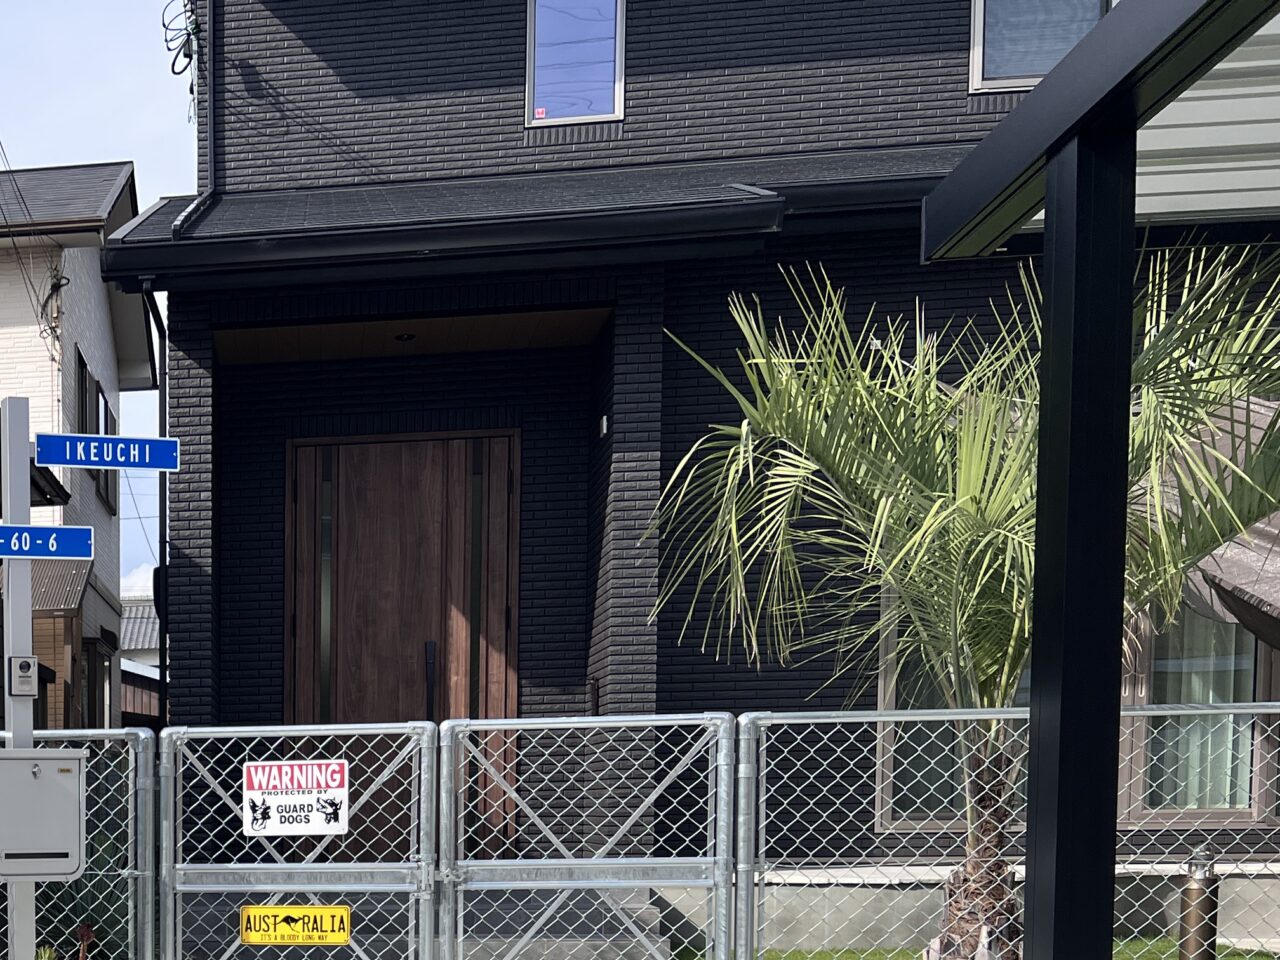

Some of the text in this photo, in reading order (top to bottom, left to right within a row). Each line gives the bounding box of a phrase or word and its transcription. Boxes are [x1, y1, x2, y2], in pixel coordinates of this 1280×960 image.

[65, 440, 150, 463] IKEUCHI
[249, 763, 341, 790] WARNING
[261, 789, 313, 797] PROTECTED
[276, 803, 314, 815] GUARD
[279, 814, 311, 825] DOGS
[260, 933, 272, 941] IT'S
